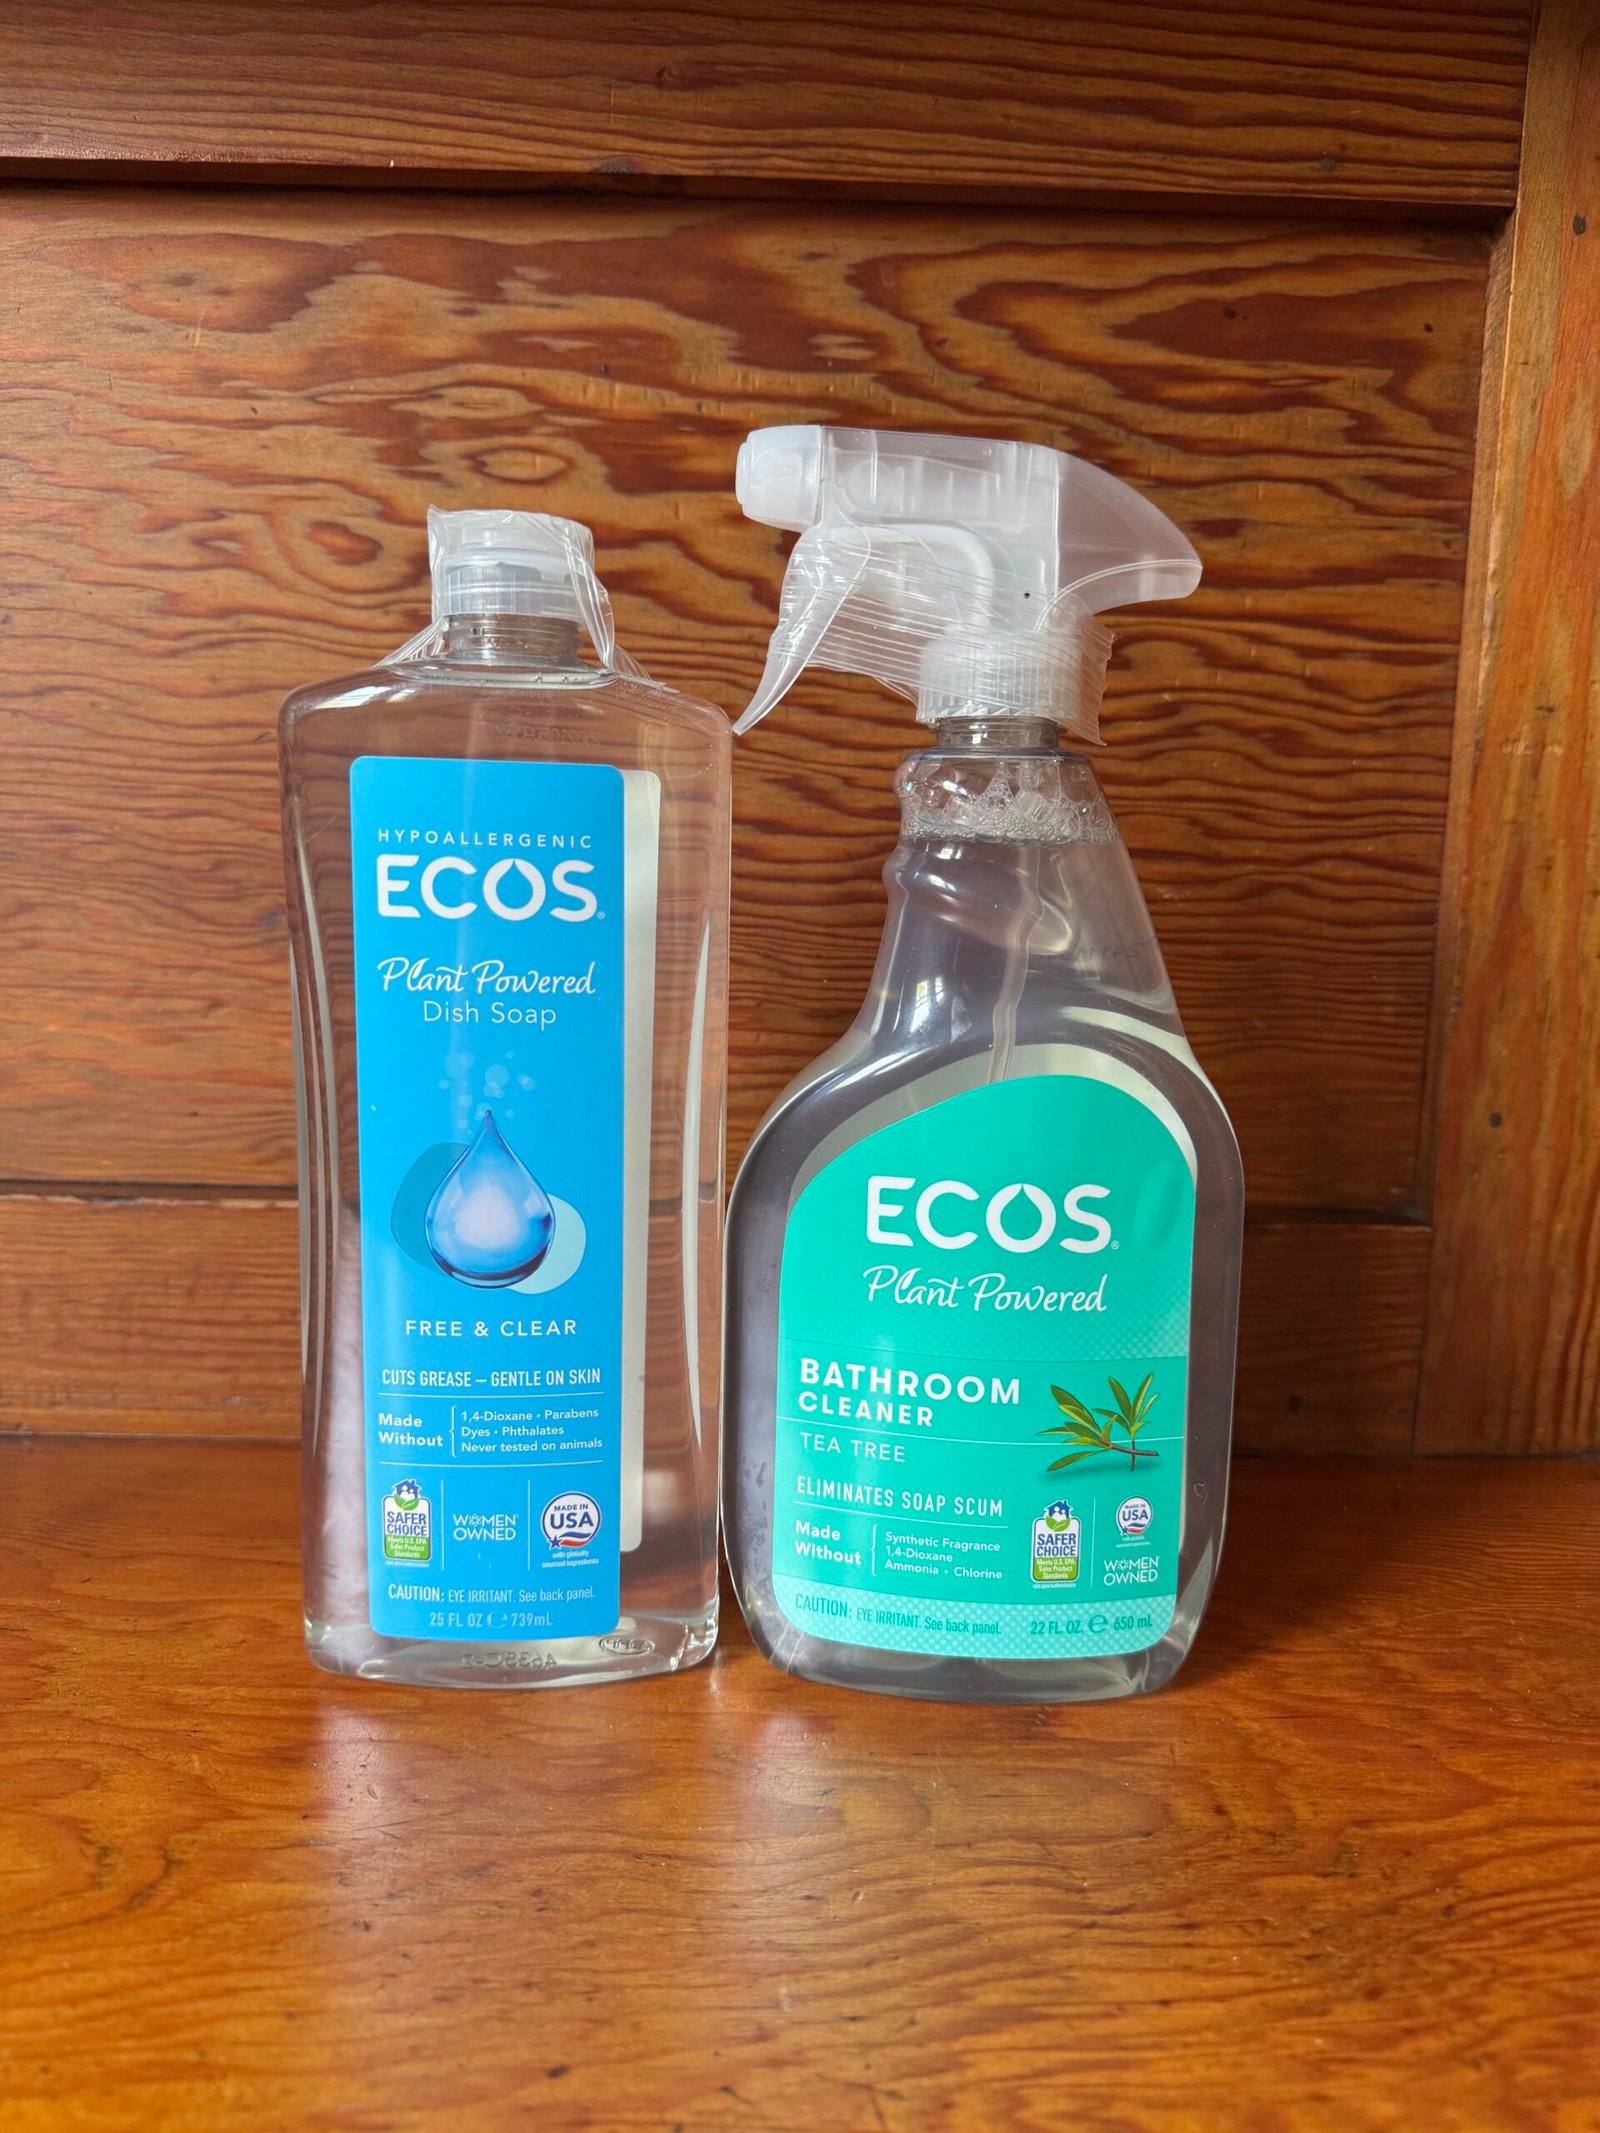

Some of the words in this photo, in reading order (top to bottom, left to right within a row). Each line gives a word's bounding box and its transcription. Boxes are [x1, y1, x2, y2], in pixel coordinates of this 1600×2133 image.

[378, 829, 592, 849] HYPOALLERGENIC
[376, 956, 468, 992] Plant
[472, 959, 596, 994] Powered
[424, 1000, 479, 1022] Dish
[491, 1002, 556, 1032] Soap
[863, 1265, 964, 1308] Plant
[968, 1273, 1108, 1312] Powered
[405, 1320, 463, 1336] FREE
[474, 1321, 489, 1337] &
[500, 1320, 577, 1336] CLEAR
[382, 1369, 416, 1386] CUTS
[420, 1370, 472, 1387] GREASE
[491, 1370, 541, 1387] GENTLE
[546, 1370, 564, 1386] ON
[569, 1367, 601, 1385] SKIN
[800, 1357, 1020, 1405] BATHROOM
[461, 1410, 533, 1423] 1,4-Dioxane
[544, 1408, 599, 1420] Parabens
[799, 1391, 933, 1427] CLEANER
[378, 1412, 423, 1427] Made
[378, 1431, 443, 1447] Without
[461, 1426, 491, 1439] Dyes
[502, 1425, 565, 1437] Phthalates
[461, 1441, 497, 1452] Never
[500, 1441, 538, 1452] tested
[541, 1443, 556, 1451] on
[559, 1438, 602, 1450] animals
[800, 1431, 841, 1454] TEA
[850, 1439, 906, 1463] TREE
[797, 1475, 894, 1507] ELIMINATES
[902, 1491, 946, 1513] SOAP
[954, 1496, 1003, 1517] SCUM
[554, 1504, 578, 1512] MADE
[1122, 1509, 1148, 1521] USA
[387, 1511, 427, 1525] SAFER
[550, 1513, 594, 1530] USA
[386, 1523, 427, 1537] CHOICE
[453, 1527, 516, 1541] OWNED
[795, 1520, 841, 1540] Made
[885, 1531, 939, 1547] Synthetic
[943, 1538, 1001, 1552] Fragrance
[1037, 1533, 1076, 1545] SAFER
[795, 1540, 861, 1565] Without
[885, 1545, 953, 1562] 1,4-Dioxane
[1037, 1546, 1076, 1556] CHOICE
[885, 1560, 939, 1575] Ammonia
[954, 1566, 1003, 1579] Chlorine
[1103, 1569, 1158, 1586] OWNED
[388, 1584, 445, 1601] CAUTION:
[448, 1589, 465, 1602] EYE
[469, 1589, 516, 1603] IRRITANT.
[519, 1589, 537, 1602] See
[540, 1588, 563, 1601] back
[566, 1586, 596, 1603] panel.
[429, 1612, 444, 1627] 25
[448, 1612, 463, 1627] FL
[467, 1613, 483, 1627] OZ
[511, 1611, 554, 1627] 739mL
[795, 1593, 852, 1618] CAUTION:
[857, 1608, 872, 1622] EYE
[876, 1610, 921, 1629] IRRITANT.
[925, 1617, 942, 1630] See
[946, 1619, 969, 1632] back
[972, 1621, 1002, 1636] panel.
[1031, 1621, 1045, 1635] 22
[1066, 1620, 1083, 1634] OZ.
[1114, 1616, 1134, 1631] 650
[1138, 1615, 1152, 1628] mL
